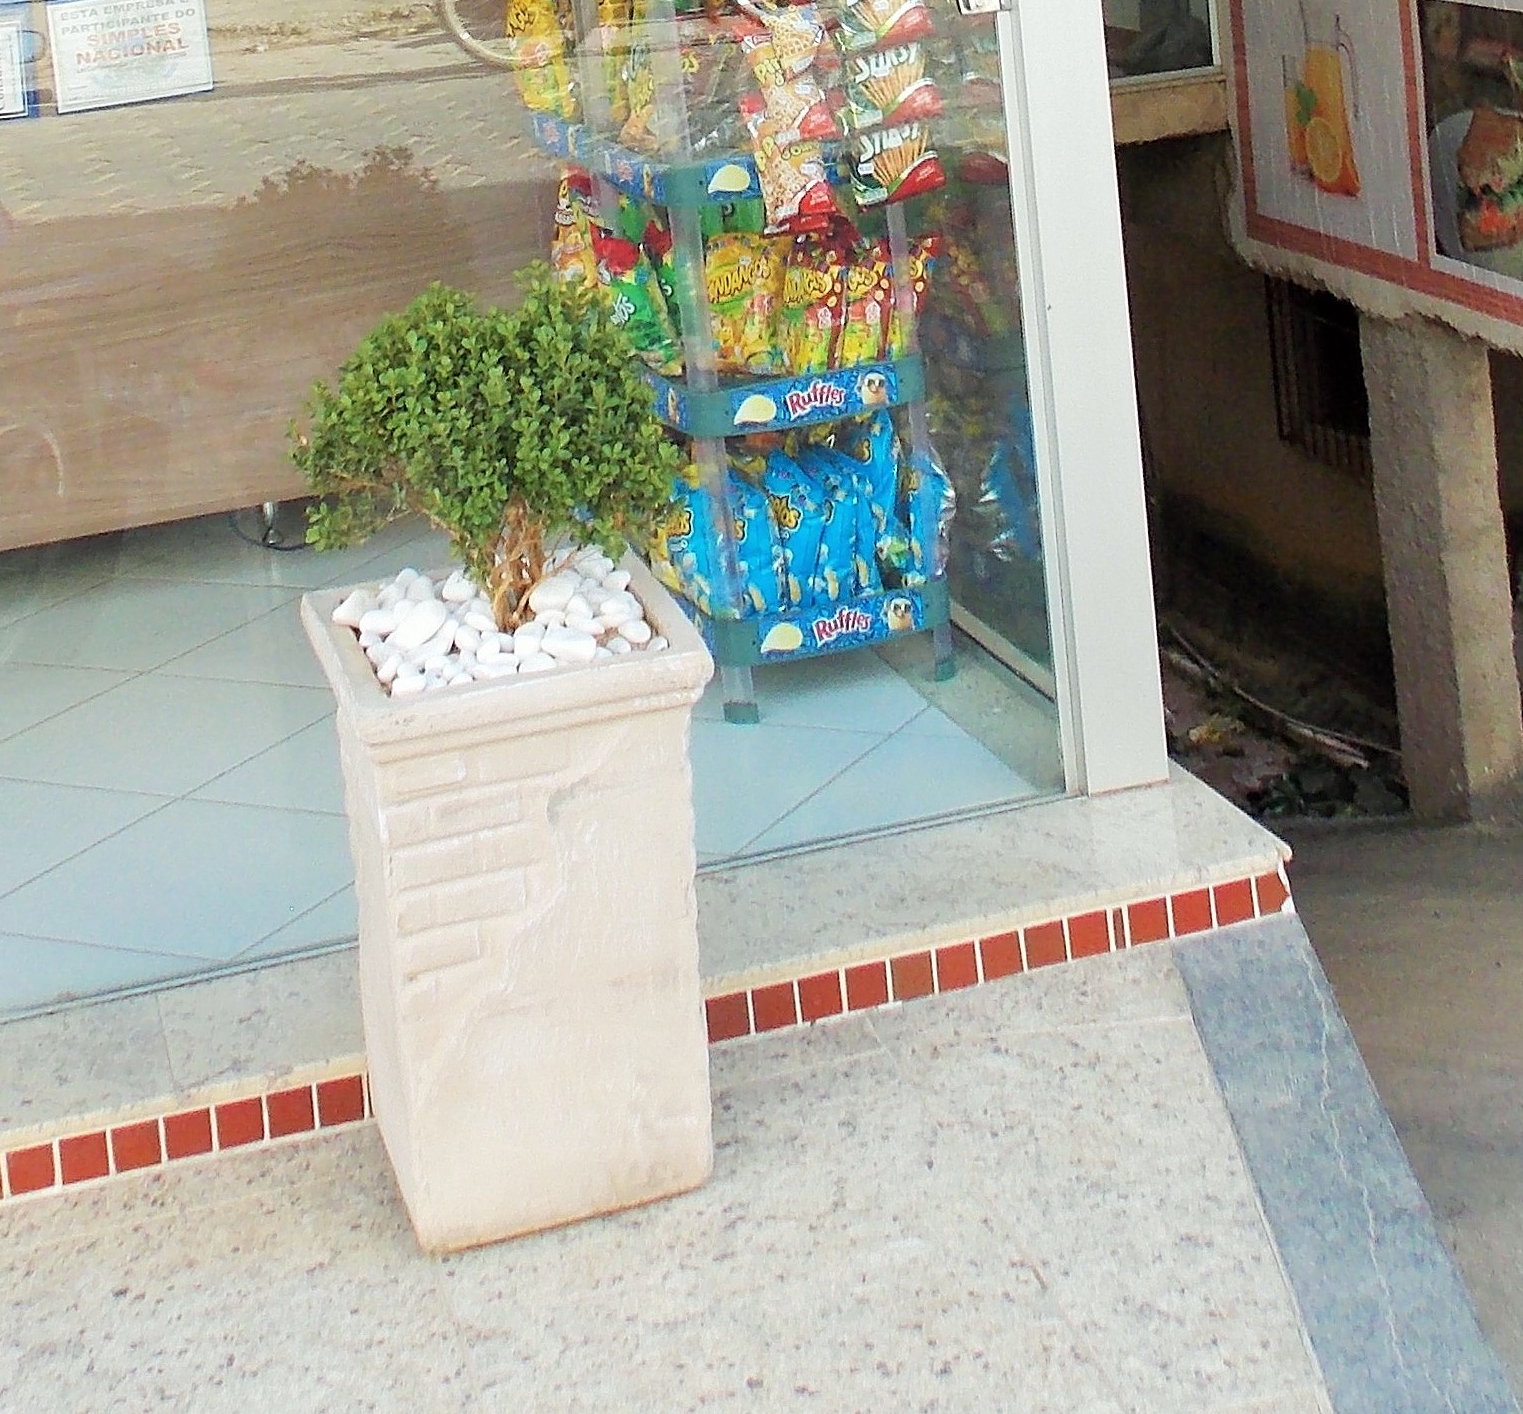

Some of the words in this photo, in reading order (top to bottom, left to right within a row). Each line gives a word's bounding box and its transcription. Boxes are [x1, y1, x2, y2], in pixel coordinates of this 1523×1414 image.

[61, 8, 98, 21] ESTA
[61, 11, 170, 35] PARTICIPANTE
[175, 7, 196, 19] DO
[87, 21, 181, 47] SIMPLES
[76, 38, 190, 65] NACIONAL
[787, 380, 845, 418] Ruffles
[813, 606, 872, 644] Ruffles
